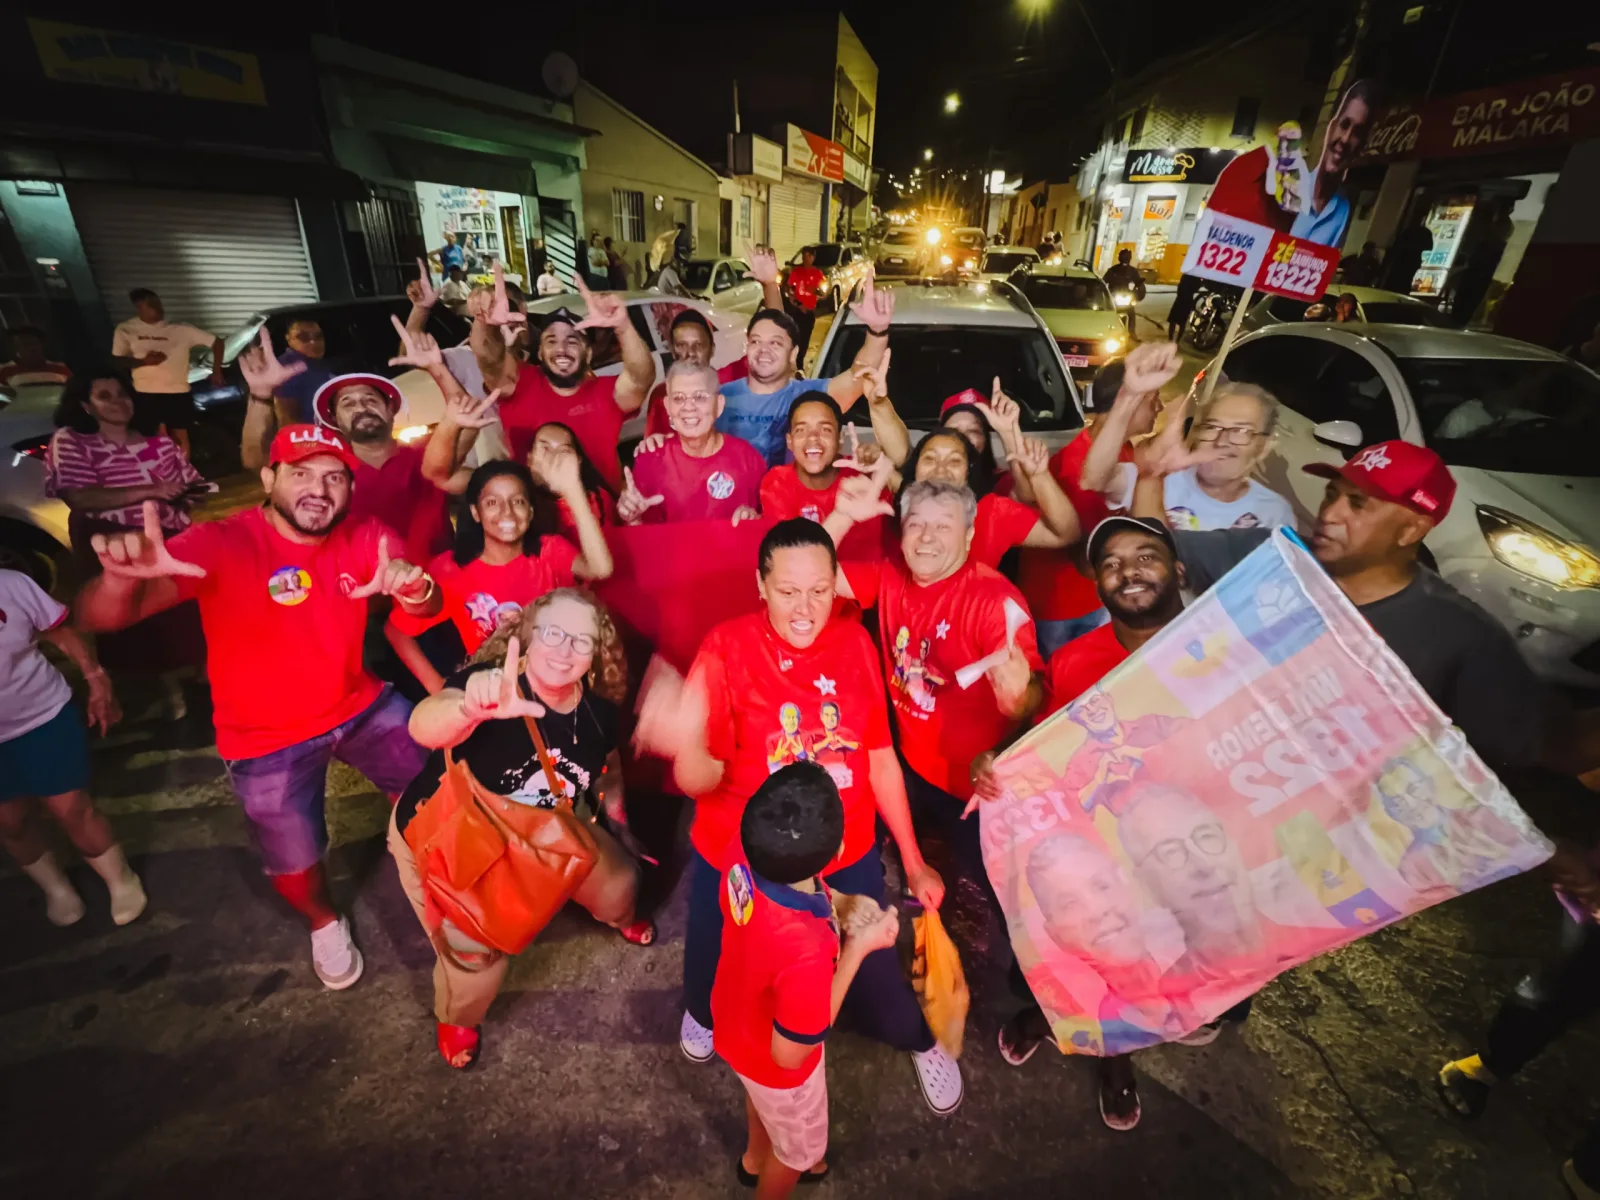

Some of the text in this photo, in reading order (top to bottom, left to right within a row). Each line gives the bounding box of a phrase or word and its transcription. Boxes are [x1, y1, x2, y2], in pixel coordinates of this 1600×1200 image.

[1451, 80, 1596, 126] BAR JOÃO
[1452, 112, 1571, 148] MALAKA
[1197, 241, 1247, 276] 1322
[1264, 261, 1322, 296] 13222
[289, 427, 344, 451] LULA
